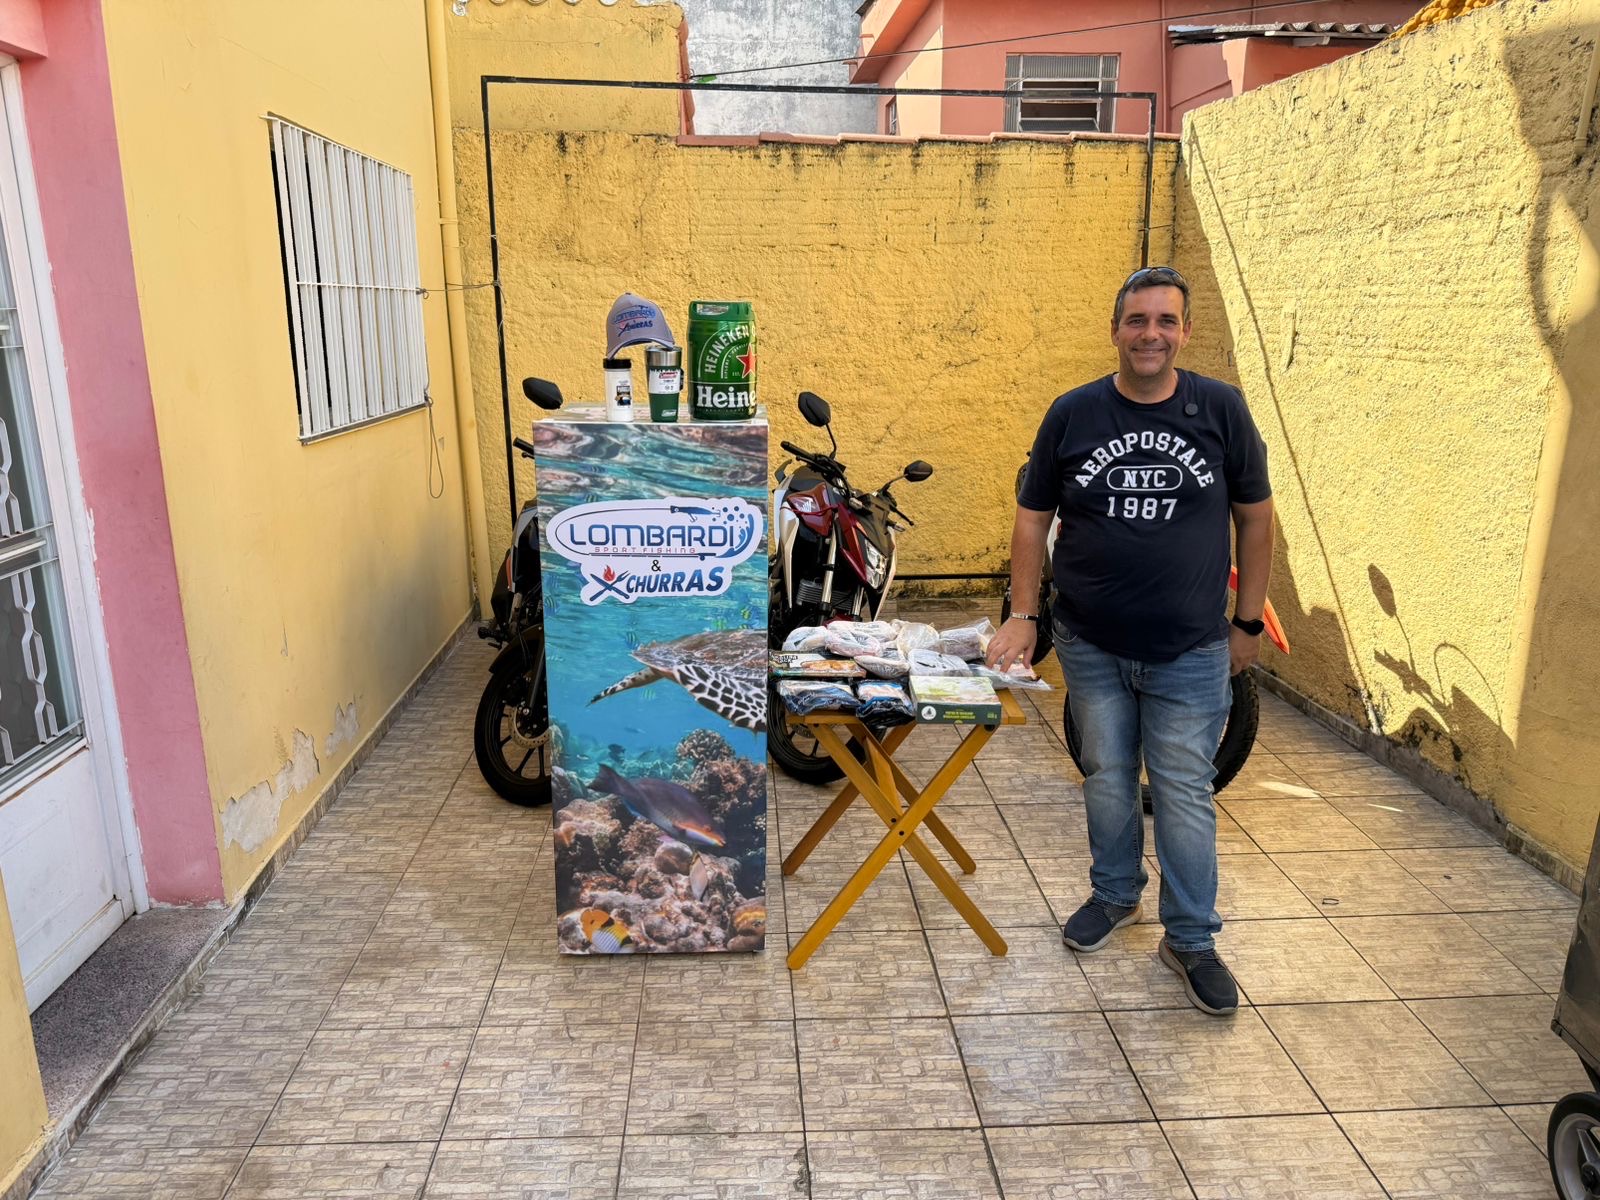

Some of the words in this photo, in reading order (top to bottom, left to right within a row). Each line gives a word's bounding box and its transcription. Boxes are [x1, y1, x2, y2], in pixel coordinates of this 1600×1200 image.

[704, 324, 750, 374] HEINEKEN
[1074, 430, 1215, 488] AEROPOSTALE
[1122, 469, 1167, 488] NYC
[1106, 496, 1178, 520] 1987
[569, 523, 734, 547] LOMBARDI
[651, 559, 662, 572] &
